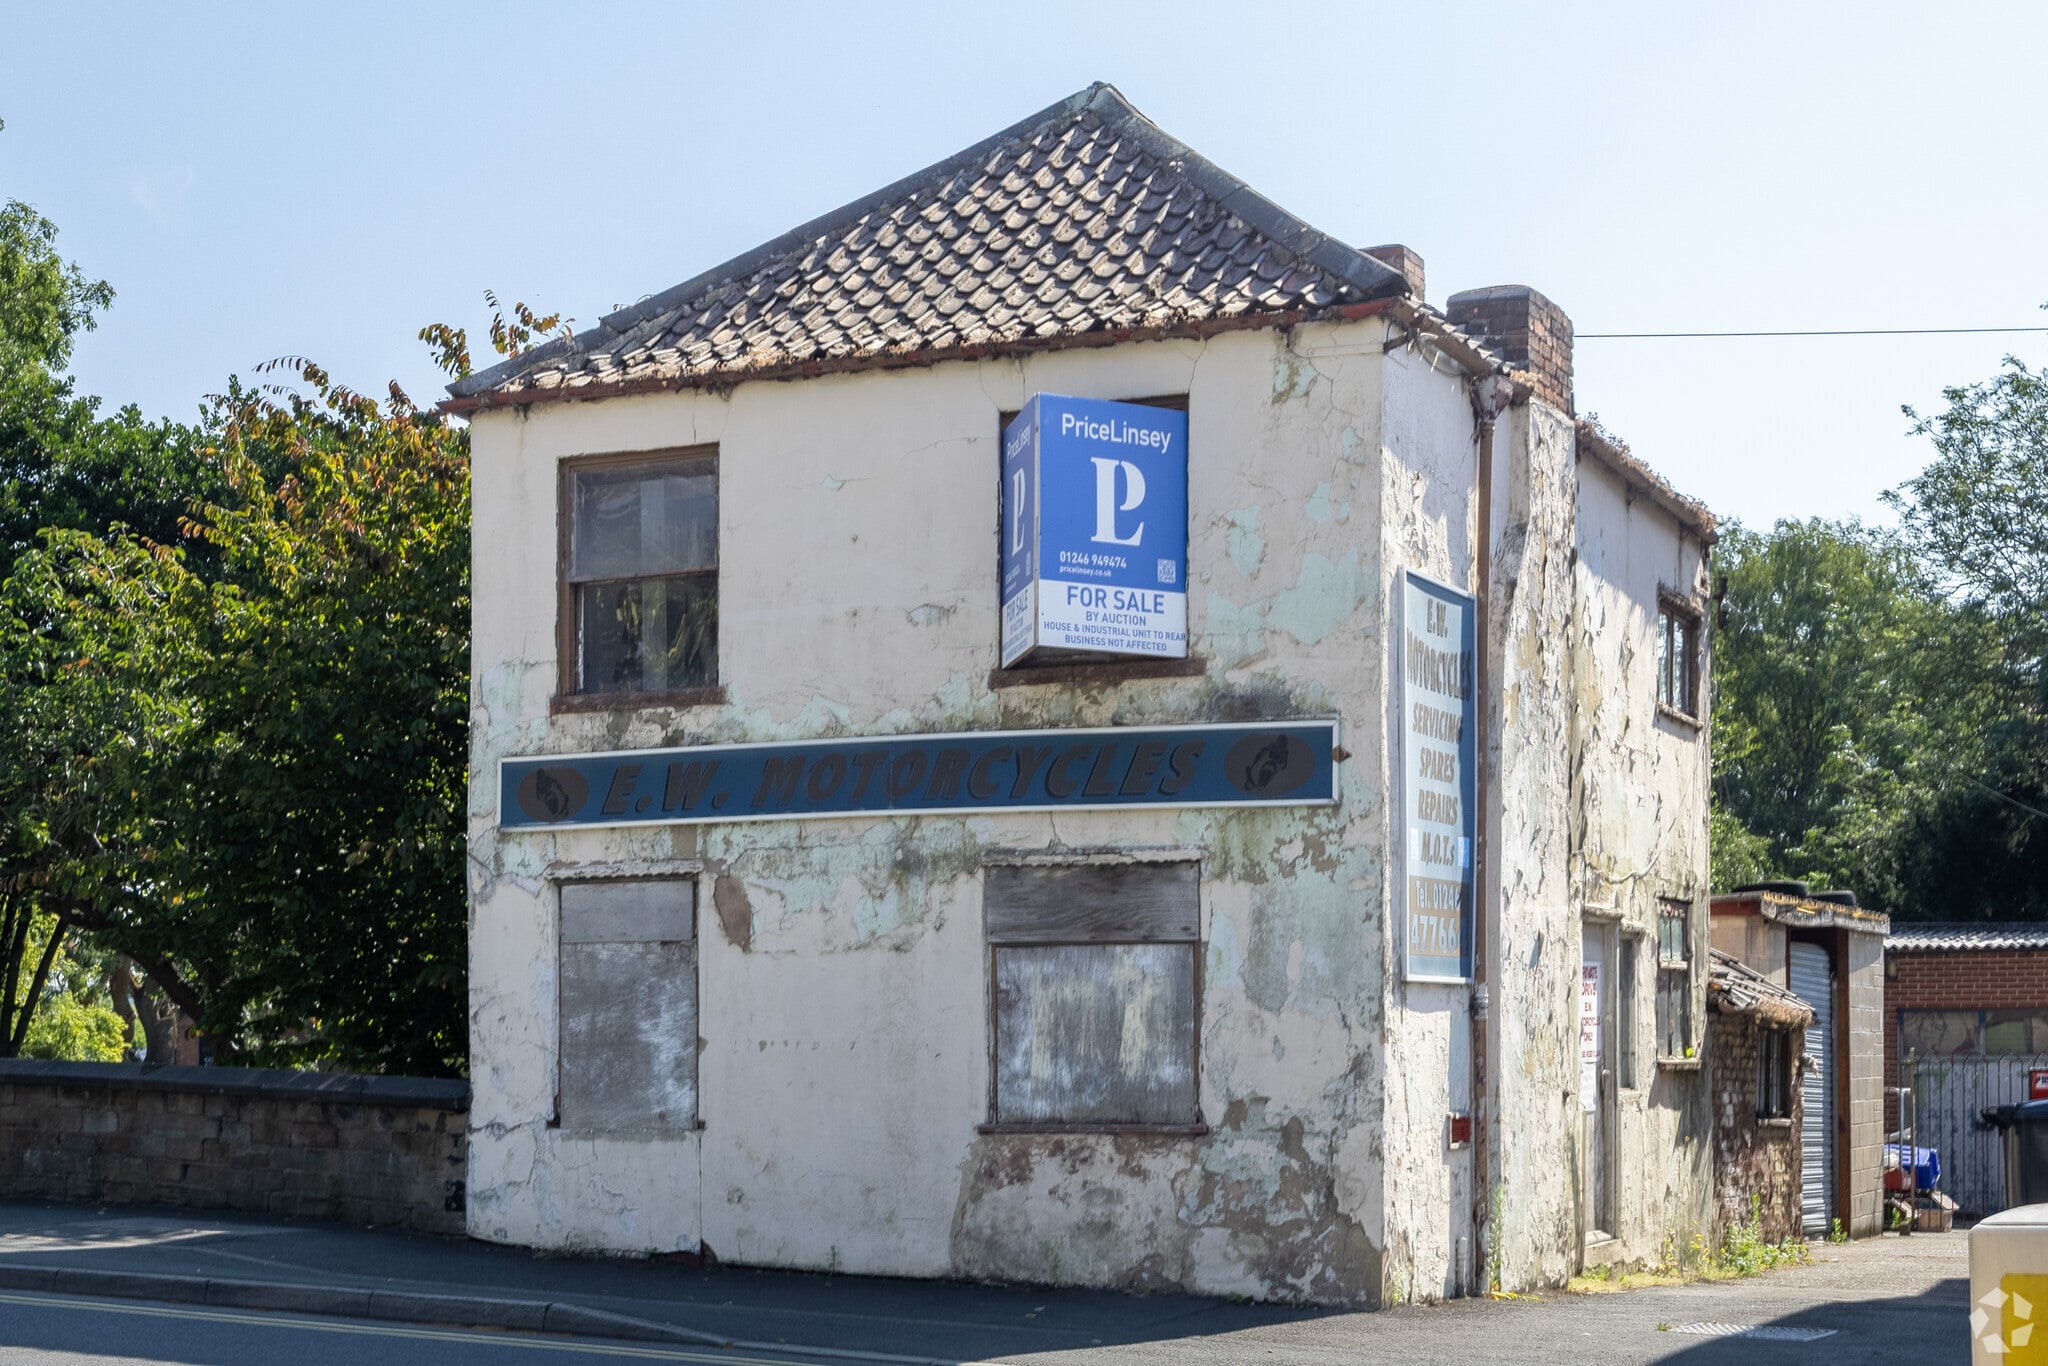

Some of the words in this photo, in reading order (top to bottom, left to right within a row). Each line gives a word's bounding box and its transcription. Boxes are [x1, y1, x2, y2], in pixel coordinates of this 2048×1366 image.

[1061, 413, 1172, 455] PriceLinsey
[1060, 550, 1090, 565] 01246
[1091, 553, 1127, 569] 949474
[1067, 585, 1107, 609] FOR
[1113, 590, 1165, 614] SALE
[1044, 620, 1072, 632] HOUSE
[1073, 623, 1080, 632] &
[1082, 624, 1131, 637] INDUSTRIAL
[1132, 629, 1152, 640] UNIT
[1153, 630, 1164, 639] TO
[1086, 610, 1100, 622] BY
[1101, 612, 1147, 627] AUCTION
[1065, 634, 1107, 647] BUSINESS
[1107, 639, 1124, 648] NOT
[1125, 640, 1168, 652] AFFECTED
[1406, 627, 1472, 702] MOTORCYCLES
[1412, 701, 1464, 744] SERVICING
[600, 760, 730, 815] E.W.
[751, 741, 1205, 810] MOTORCYCLES
[1419, 746, 1456, 785] SPARES
[1417, 789, 1458, 826] REPAIRS
[1415, 880, 1431, 910] Tel.
[1411, 913, 1467, 955] 47766
